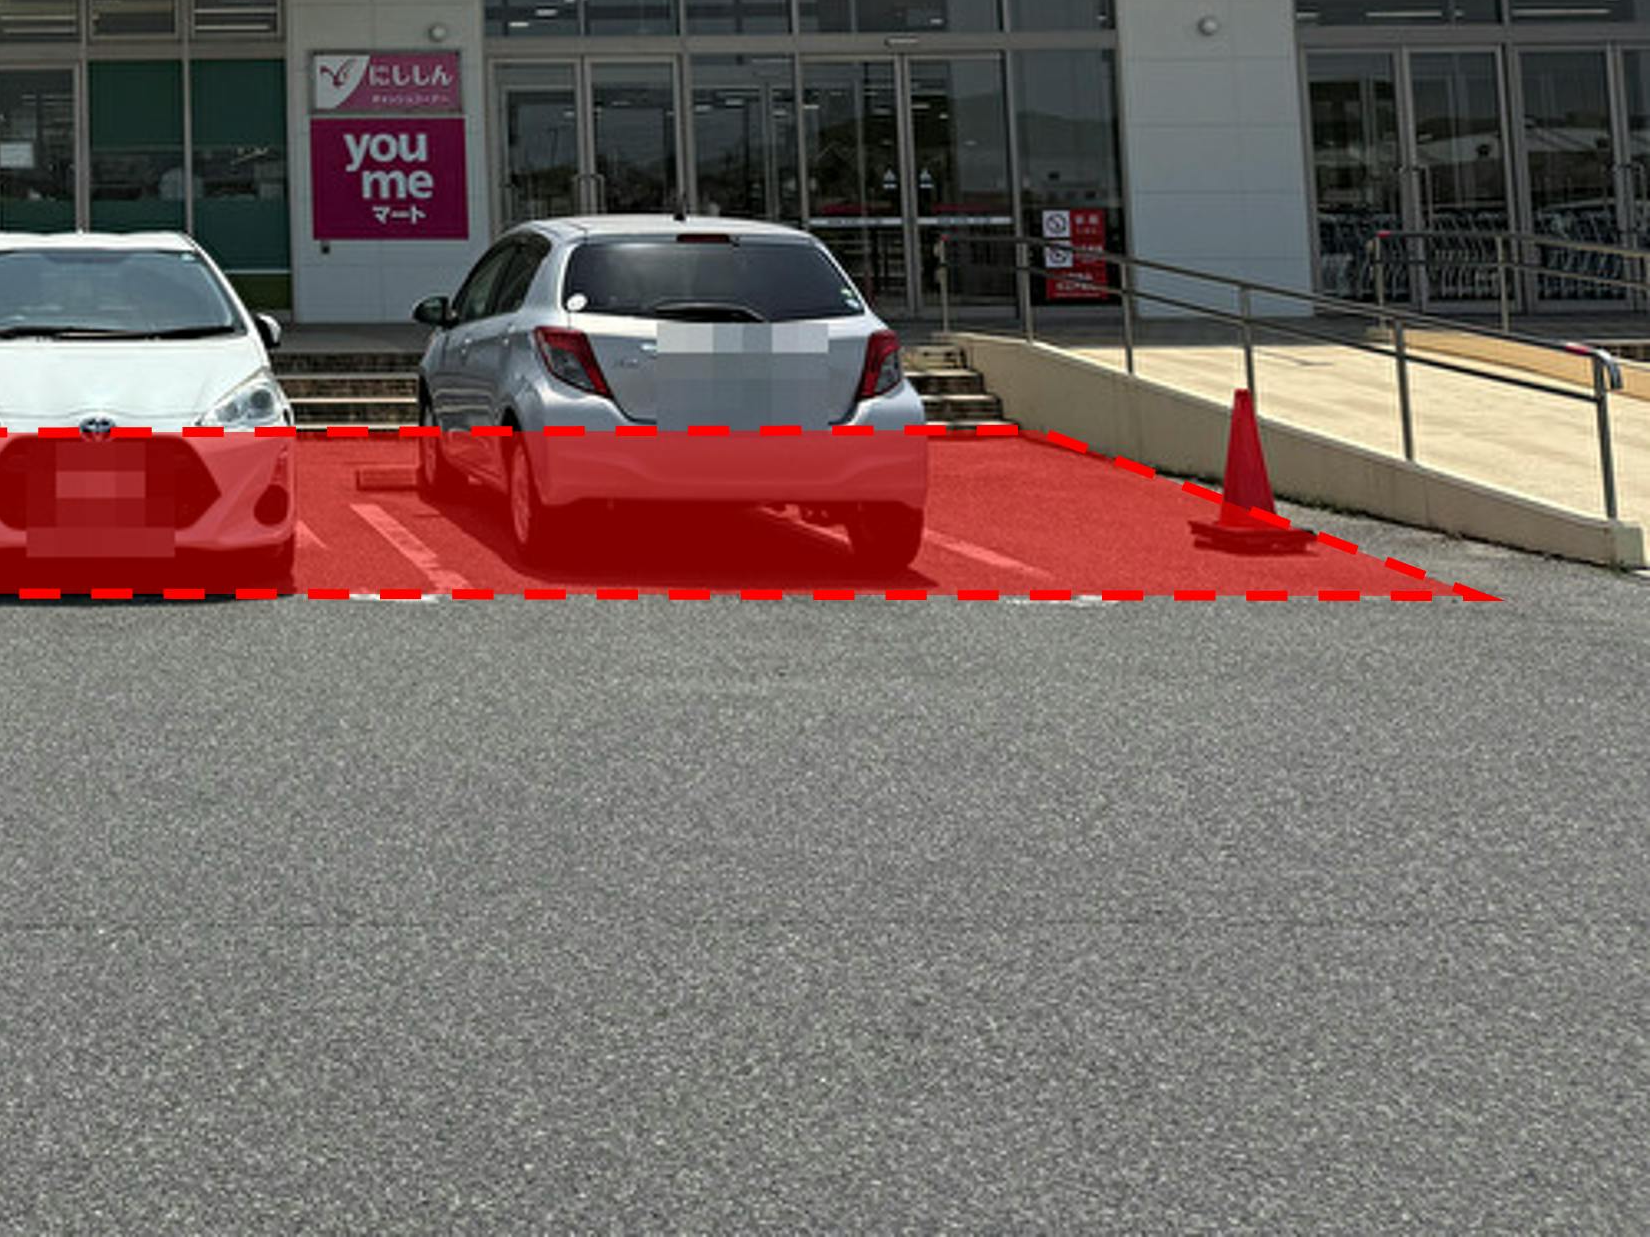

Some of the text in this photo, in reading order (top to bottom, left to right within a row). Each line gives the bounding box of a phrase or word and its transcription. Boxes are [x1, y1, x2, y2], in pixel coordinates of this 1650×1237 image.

[369, 64, 453, 86] にししん
[343, 133, 428, 172] you
[361, 168, 434, 200] me
[373, 206, 427, 224] マート
